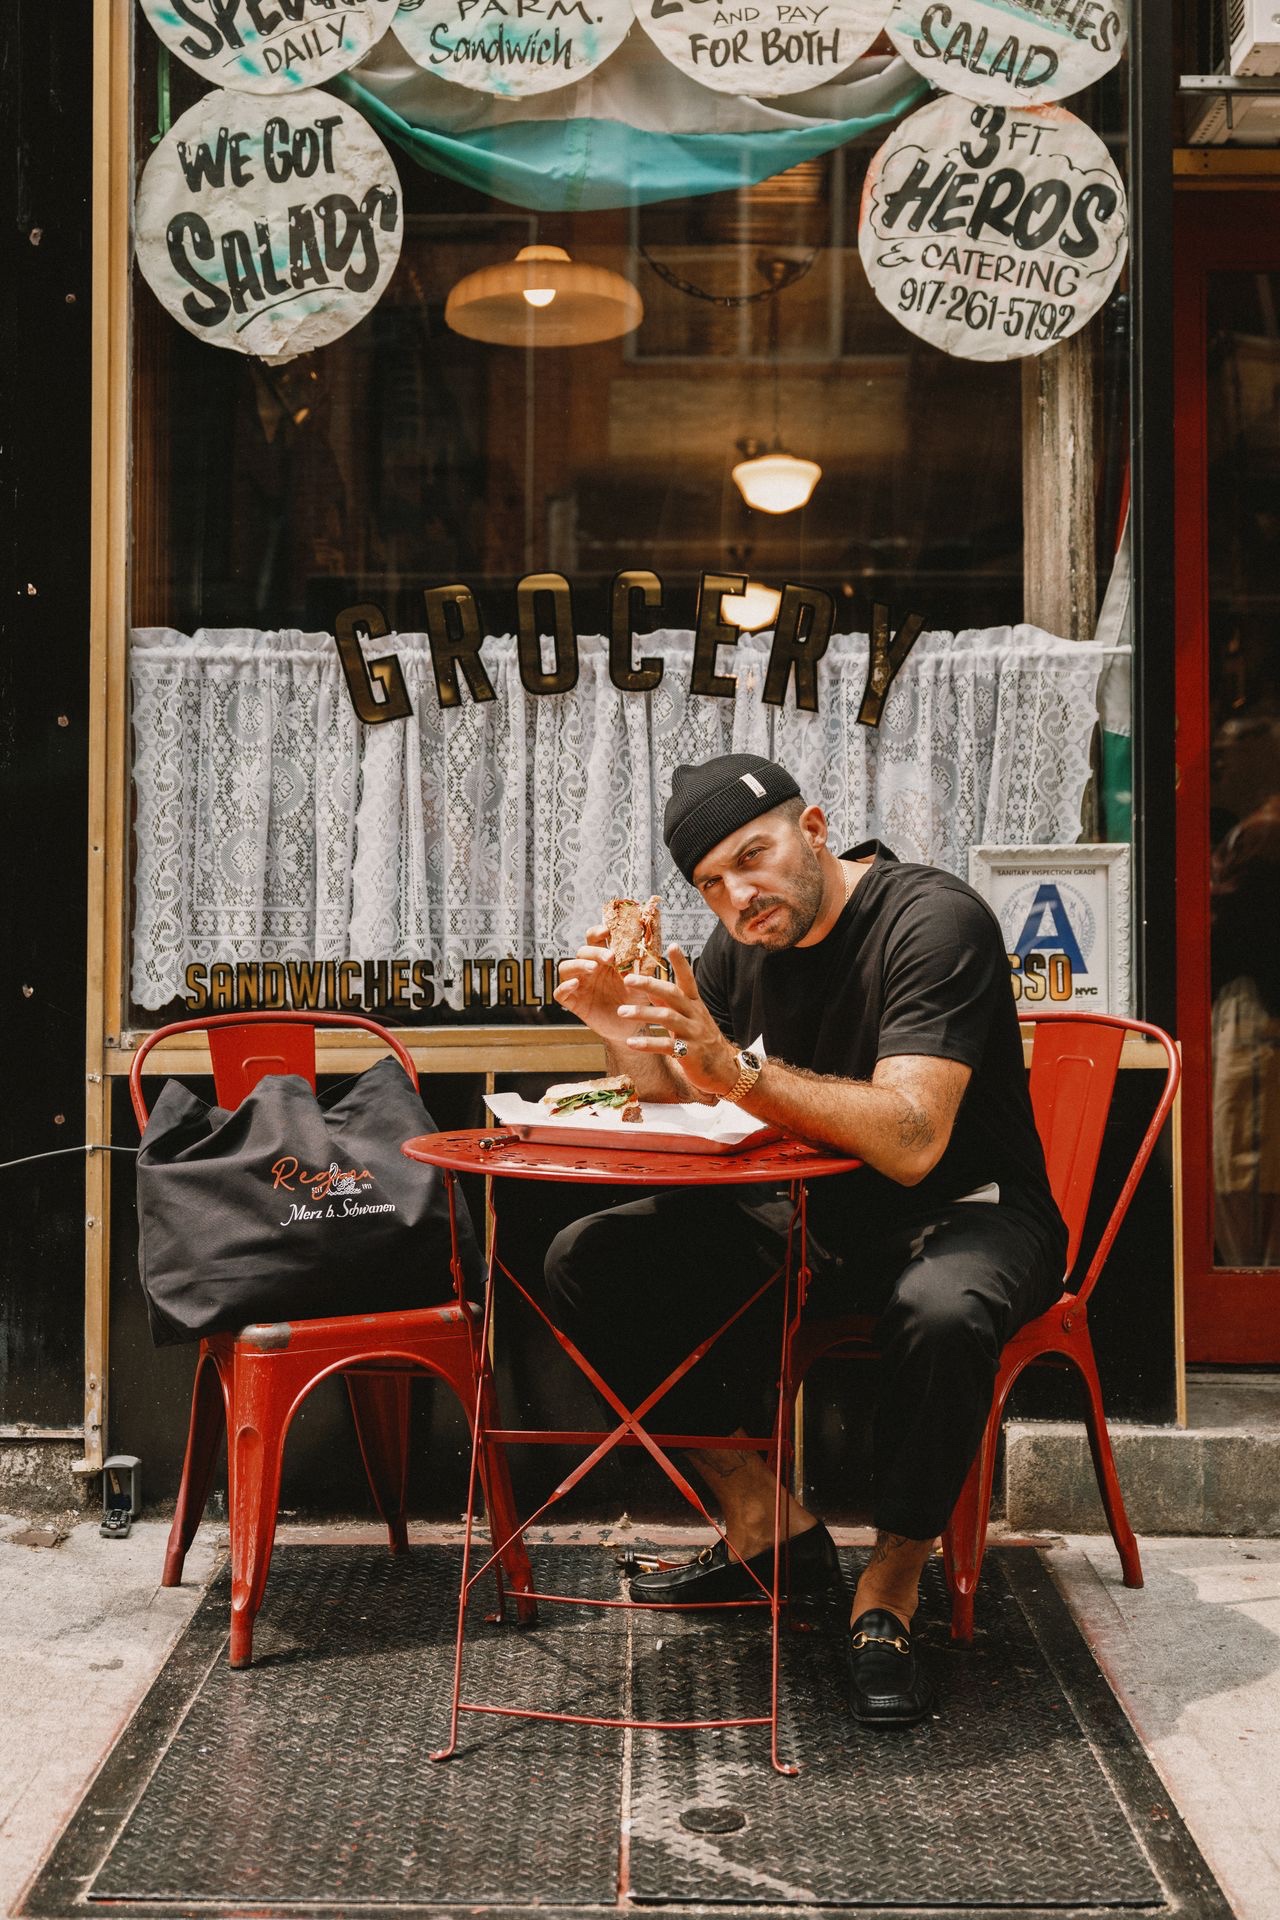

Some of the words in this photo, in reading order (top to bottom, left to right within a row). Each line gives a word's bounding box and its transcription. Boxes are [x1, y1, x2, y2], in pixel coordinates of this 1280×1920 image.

[262, 15, 347, 74] DAILY
[713, 6, 761, 26] AND
[776, 5, 830, 26] PAY
[428, 22, 573, 70] Sandwich
[688, 29, 754, 68] FOR
[760, 27, 841, 66] BOTH
[913, 3, 1060, 89] SALAD
[176, 126, 255, 193] WE
[263, 115, 344, 184] GOT
[959, 104, 1007, 169] 3
[881, 158, 1117, 258] HEROS
[165, 184, 399, 328] SALADS
[876, 242, 916, 268] &
[921, 243, 1081, 298] CATERING
[898, 277, 1076, 341] 917-261-5792
[334, 568, 927, 729] GROCERY
[1031, 868, 1072, 876] INSPECTION
[1073, 868, 1097, 876] GRADE
[1013, 884, 1089, 974] A
[185, 959, 435, 1010] SANDWICHES
[463, 958, 577, 1007] ITALI
[1075, 987, 1098, 996] NYC
[280, 1204, 323, 1227] Merz
[337, 1199, 396, 1218] Schwanen
